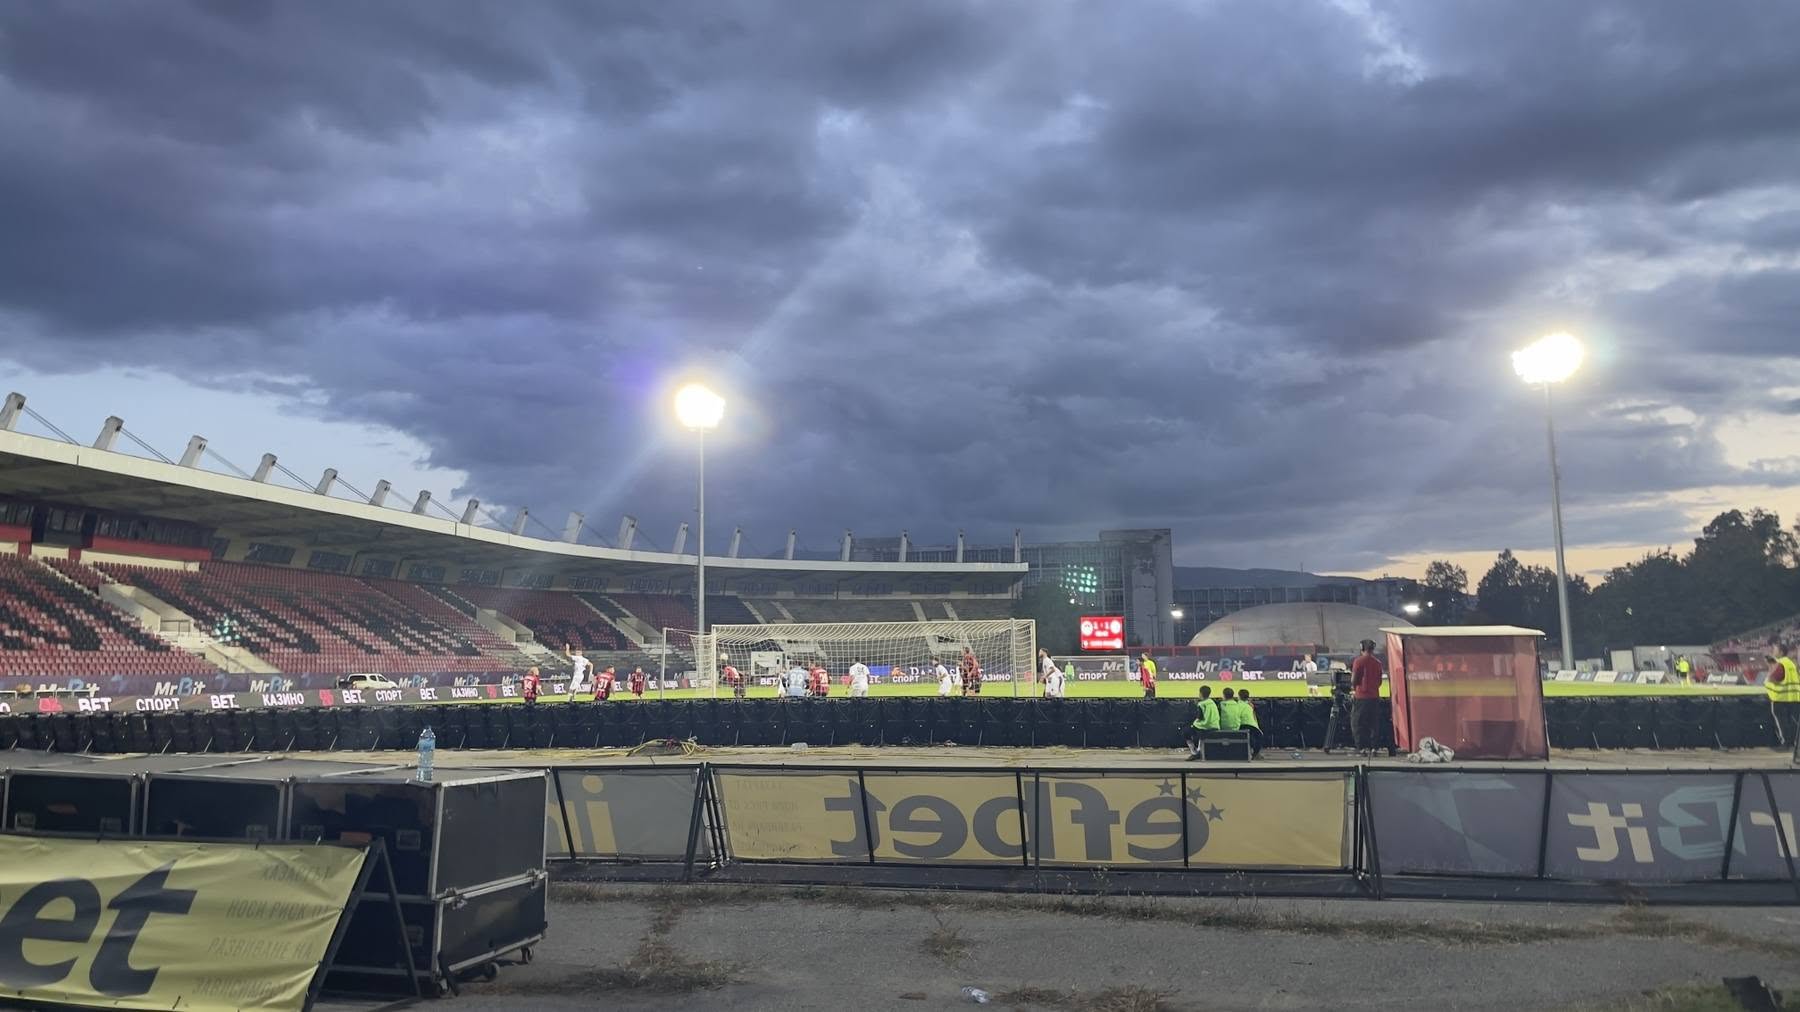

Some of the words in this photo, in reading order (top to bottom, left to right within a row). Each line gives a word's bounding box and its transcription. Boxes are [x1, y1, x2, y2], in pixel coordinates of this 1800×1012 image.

[1196, 658, 1245, 672] MrBit
[398, 674, 429, 688] MrBit
[981, 673, 1011, 681] АЗИНО
[1169, 671, 1205, 680] КАЗИНО
[154, 677, 206, 696] MrBit
[249, 675, 293, 693] MrBit
[136, 697, 180, 711] СПОРТ
[262, 693, 305, 706] КАЗИНО
[375, 690, 402, 702] СПОРТ
